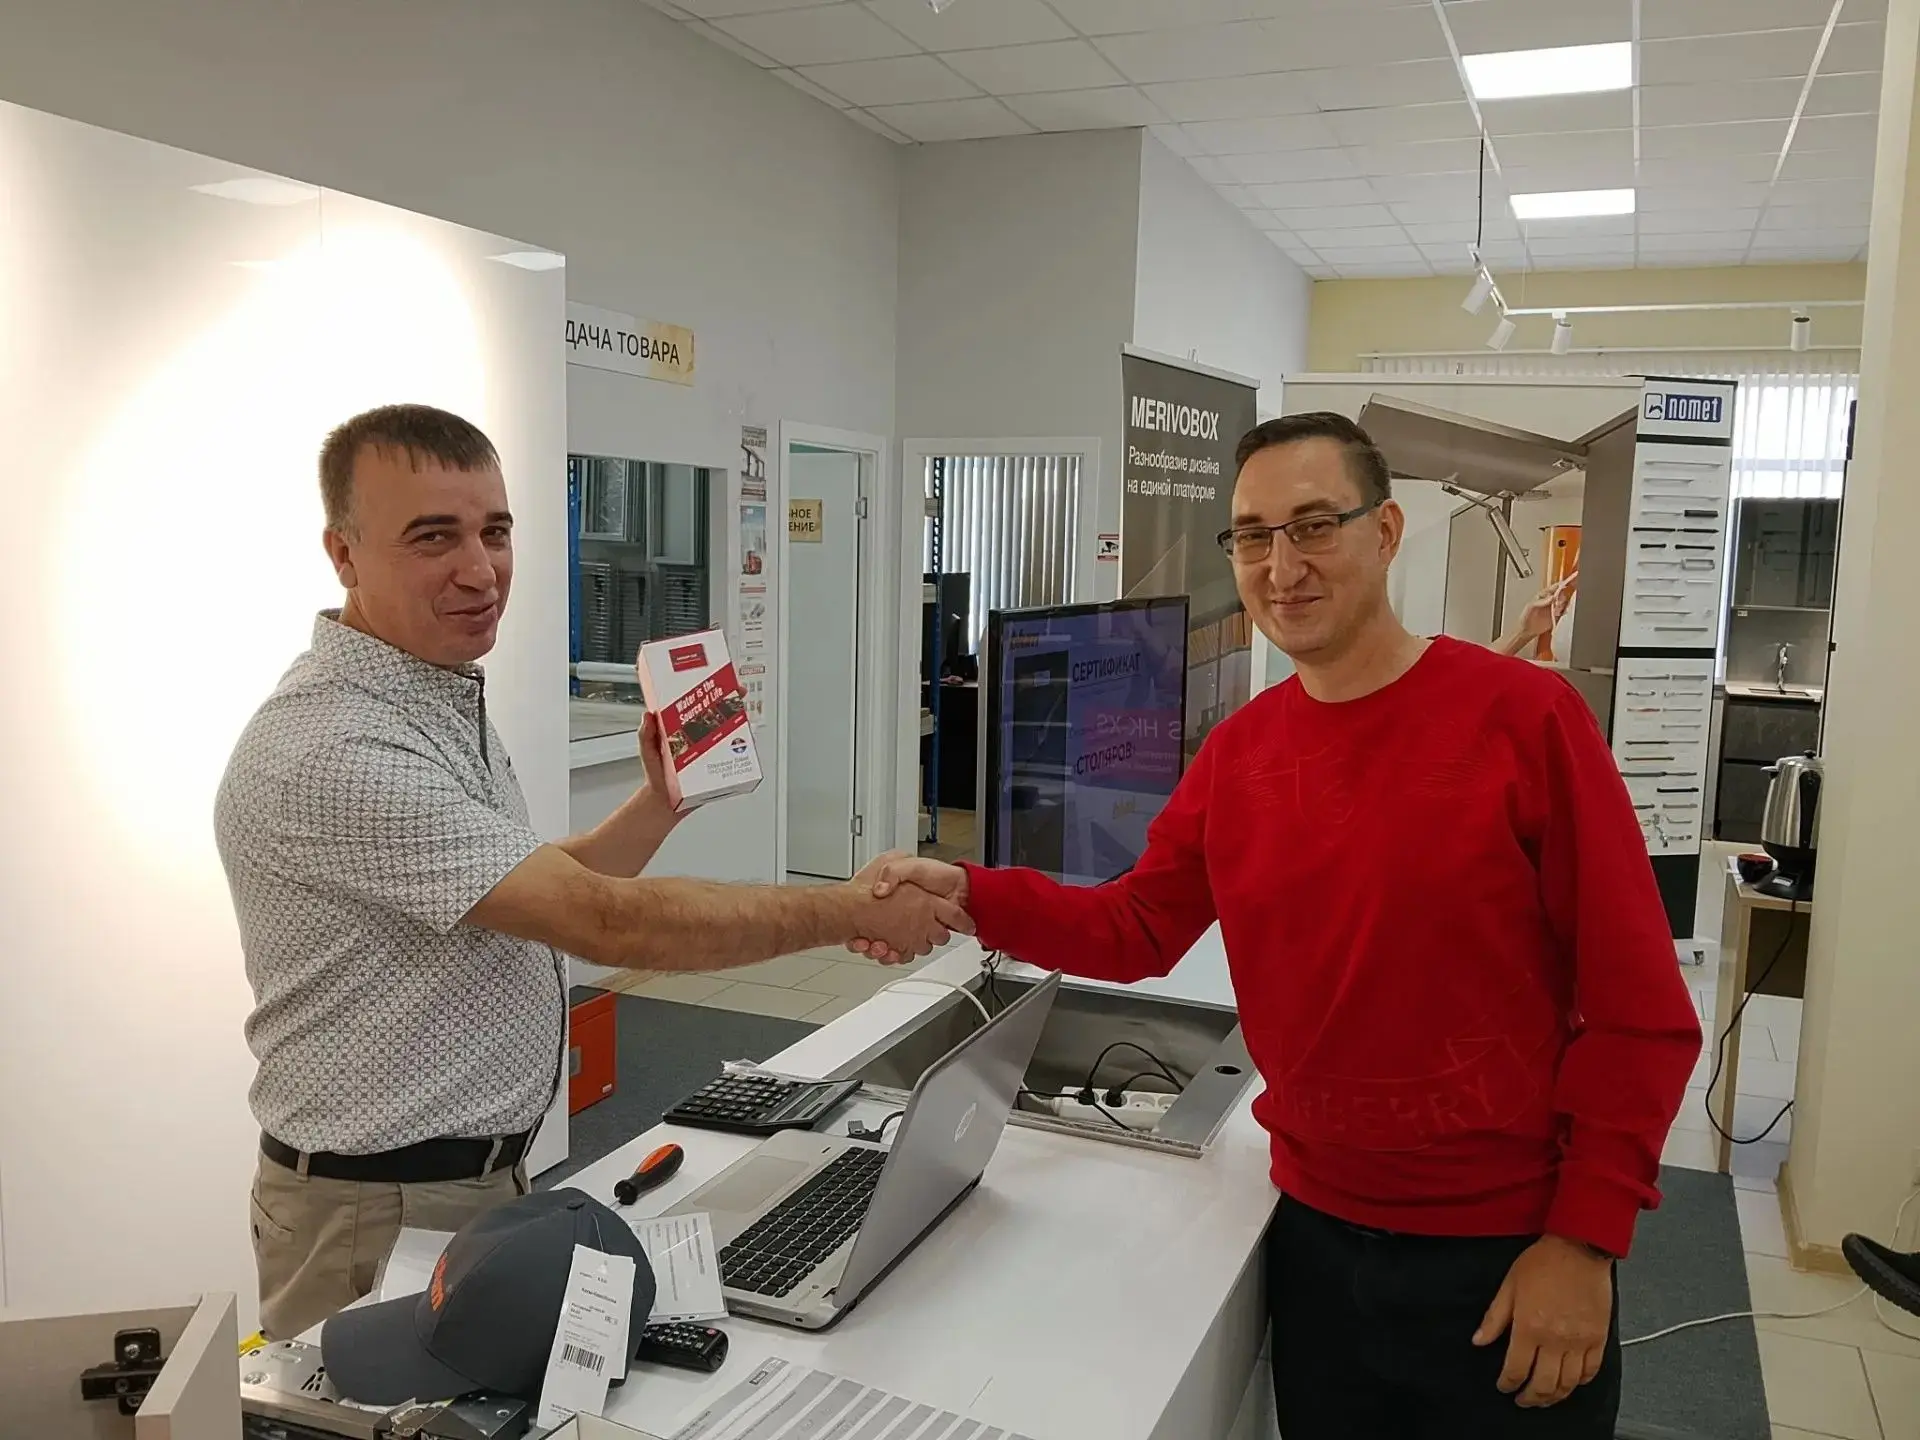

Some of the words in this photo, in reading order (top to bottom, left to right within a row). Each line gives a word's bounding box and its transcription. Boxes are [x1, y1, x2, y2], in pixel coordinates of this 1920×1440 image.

[566, 320, 612, 351] ДАЧА
[617, 331, 680, 365] ТОВАРА
[1131, 396, 1219, 441] MERIVOBOX
[1668, 397, 1718, 421] nomet
[1128, 445, 1187, 473] Разнообразие
[1188, 457, 1220, 475] дизайна
[1127, 479, 1138, 494] на
[1140, 478, 1171, 497] единой
[1172, 483, 1216, 503] платформе
[789, 508, 811, 519] НОЕ
[1072, 652, 1141, 683] СЕРТИФИКАТ
[676, 692, 696, 709] Water
[696, 685, 704, 698] is
[704, 679, 715, 692] the
[680, 703, 703, 725] Source
[702, 694, 711, 708] of
[710, 687, 723, 702] Life
